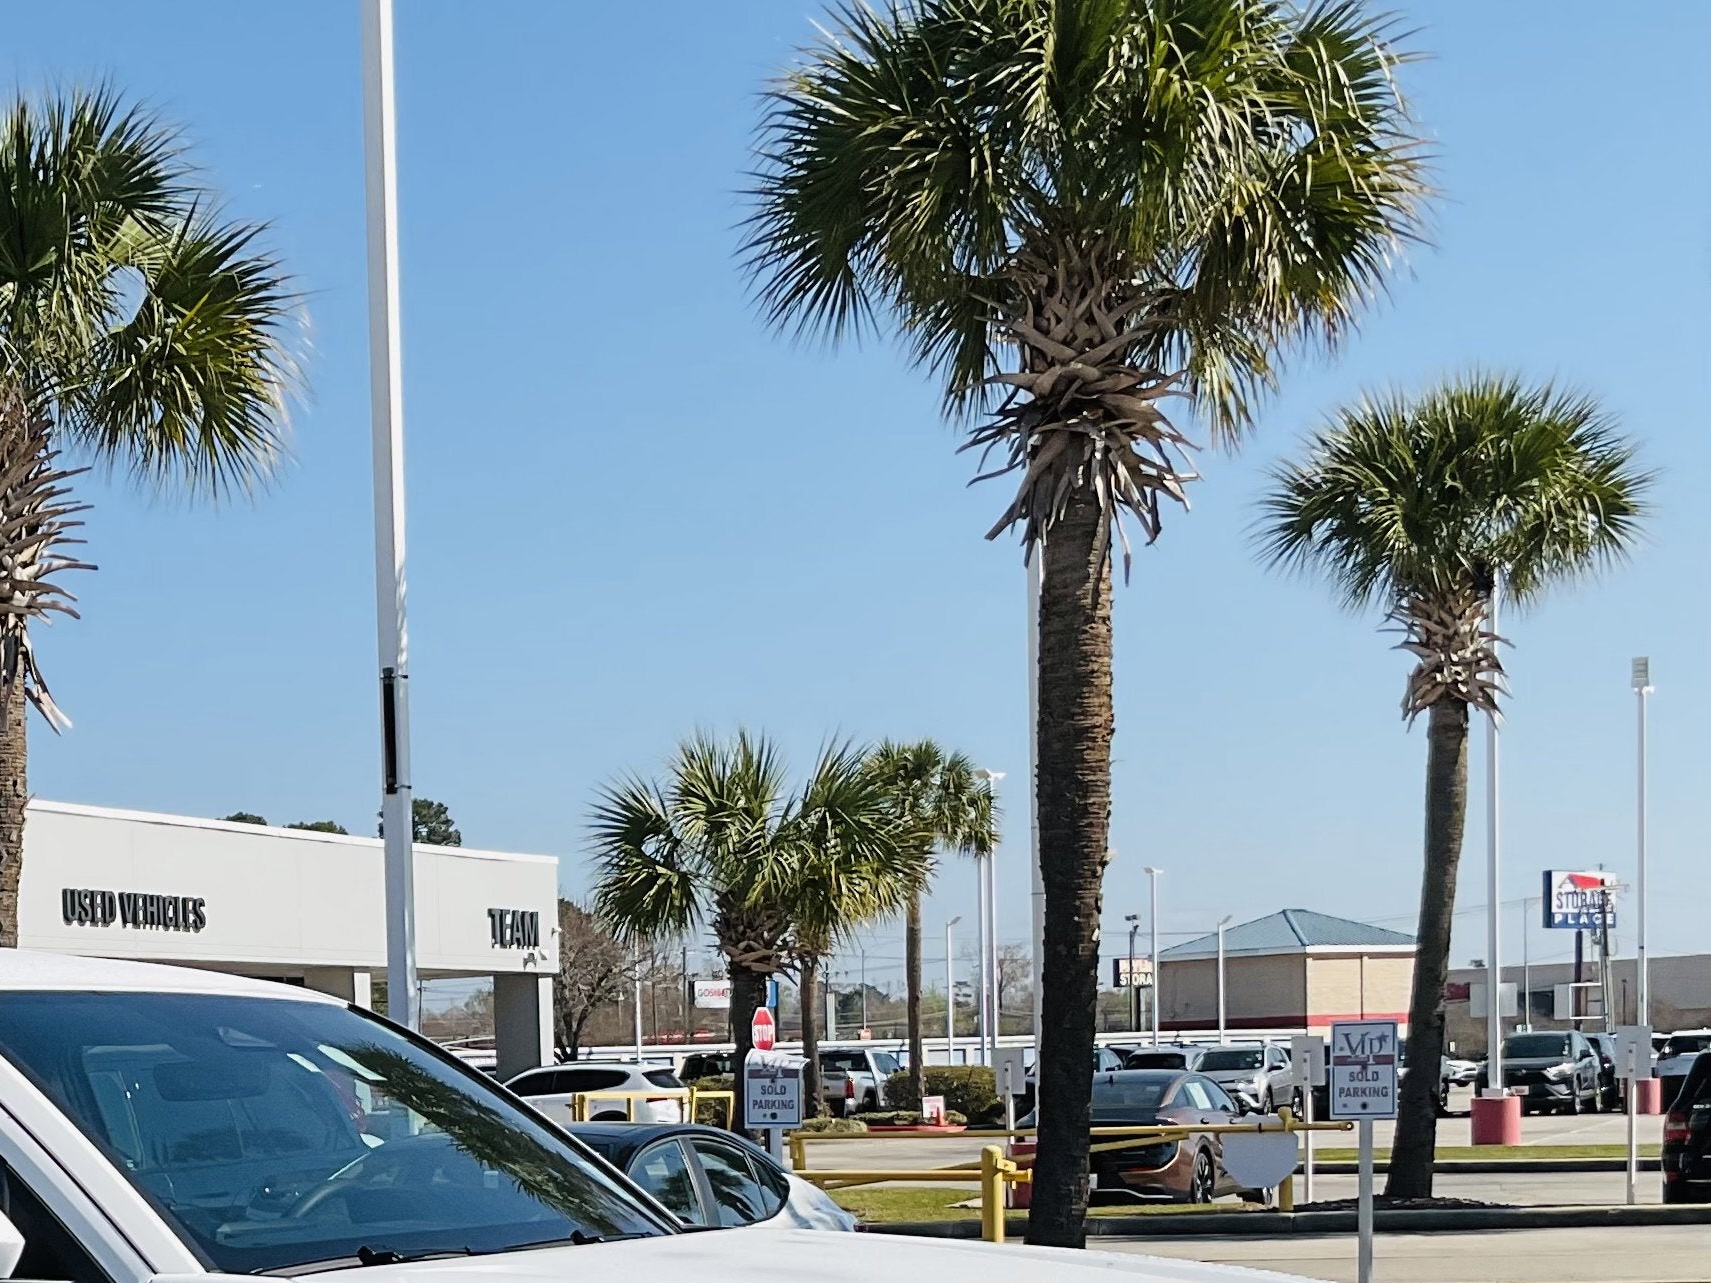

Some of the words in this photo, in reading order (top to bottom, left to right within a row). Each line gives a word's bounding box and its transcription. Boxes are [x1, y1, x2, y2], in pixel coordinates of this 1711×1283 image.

[62, 888, 116, 927] USED
[118, 892, 206, 932] VEHICLES
[1554, 912, 1615, 925] PLACE
[488, 908, 539, 949] TEAM
[753, 1024, 774, 1042] STOP
[1348, 1070, 1380, 1082] SOLD
[760, 1085, 787, 1096] SOLD
[1338, 1086, 1389, 1098] PARKING
[752, 1100, 795, 1110] PARKING
